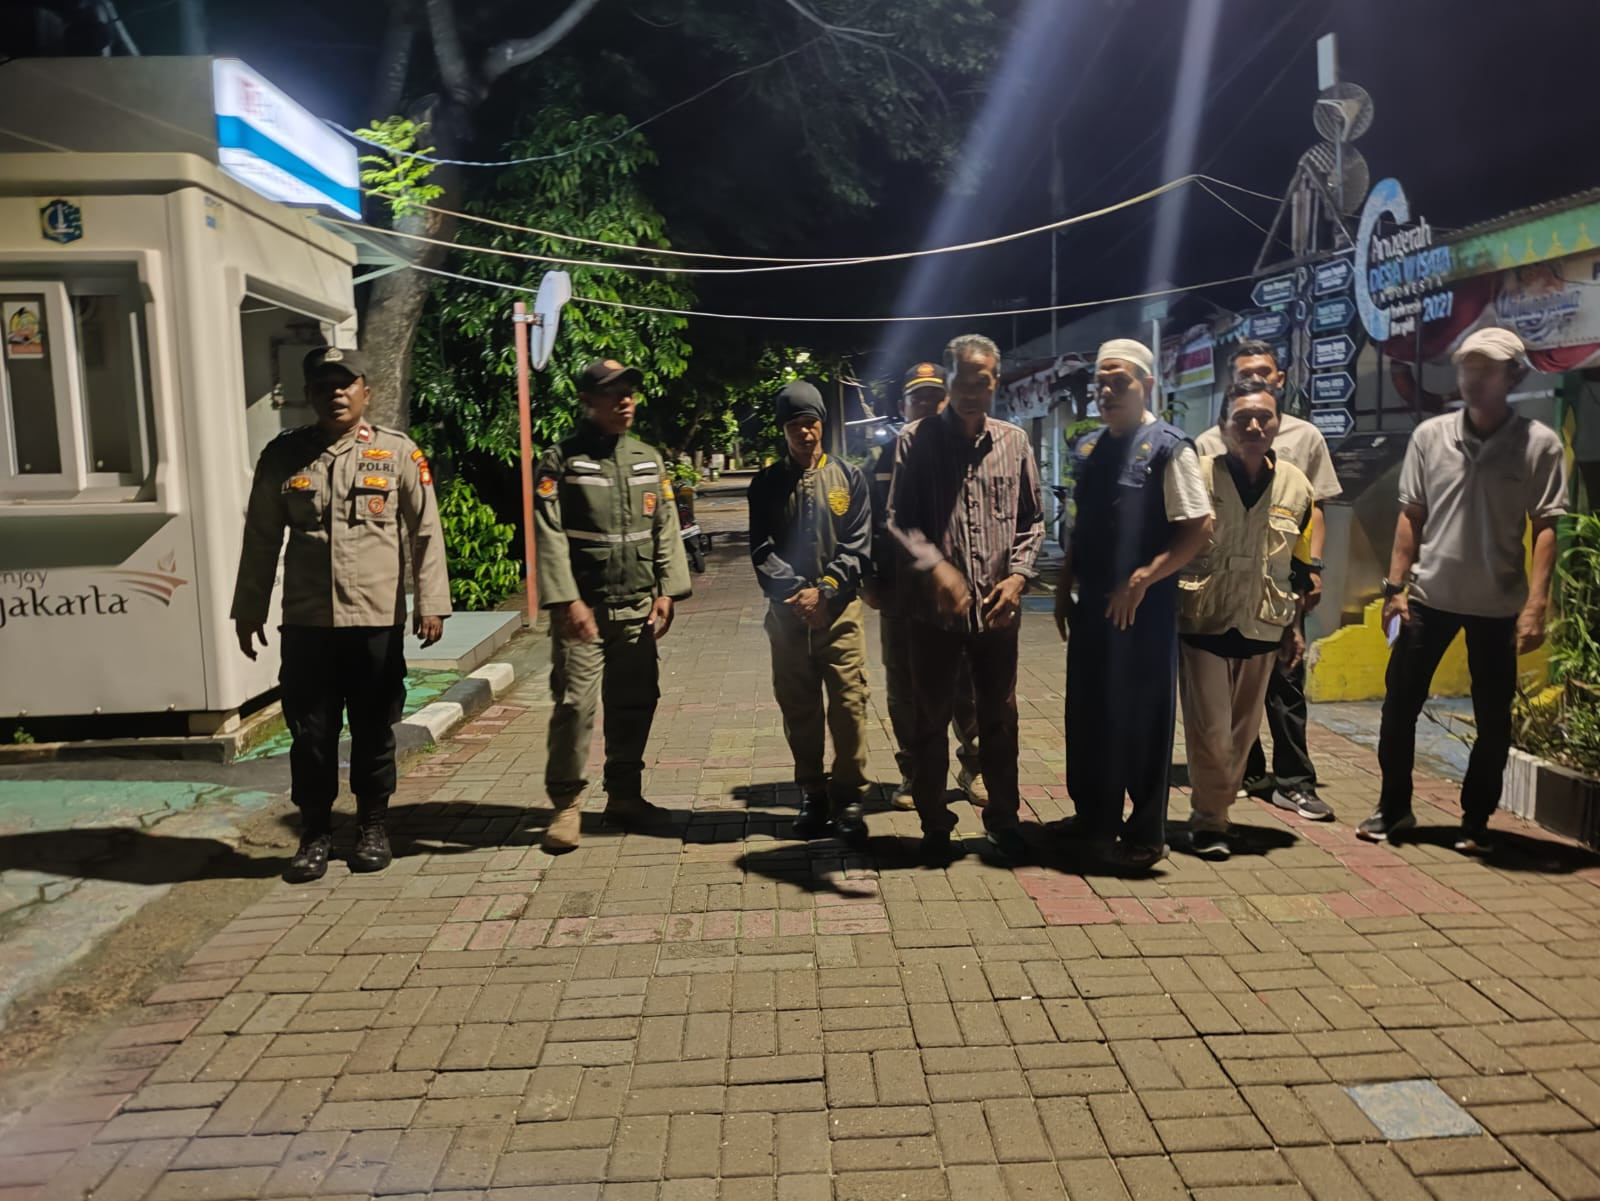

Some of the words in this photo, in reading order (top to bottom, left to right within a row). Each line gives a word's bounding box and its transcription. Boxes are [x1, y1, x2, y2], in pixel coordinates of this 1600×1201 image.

[1371, 215, 1432, 263] Anugerah
[1369, 260, 1402, 292] DESA
[1422, 291, 1453, 322] 2021
[357, 462, 395, 473] POLRI
[0, 570, 48, 590] njoy
